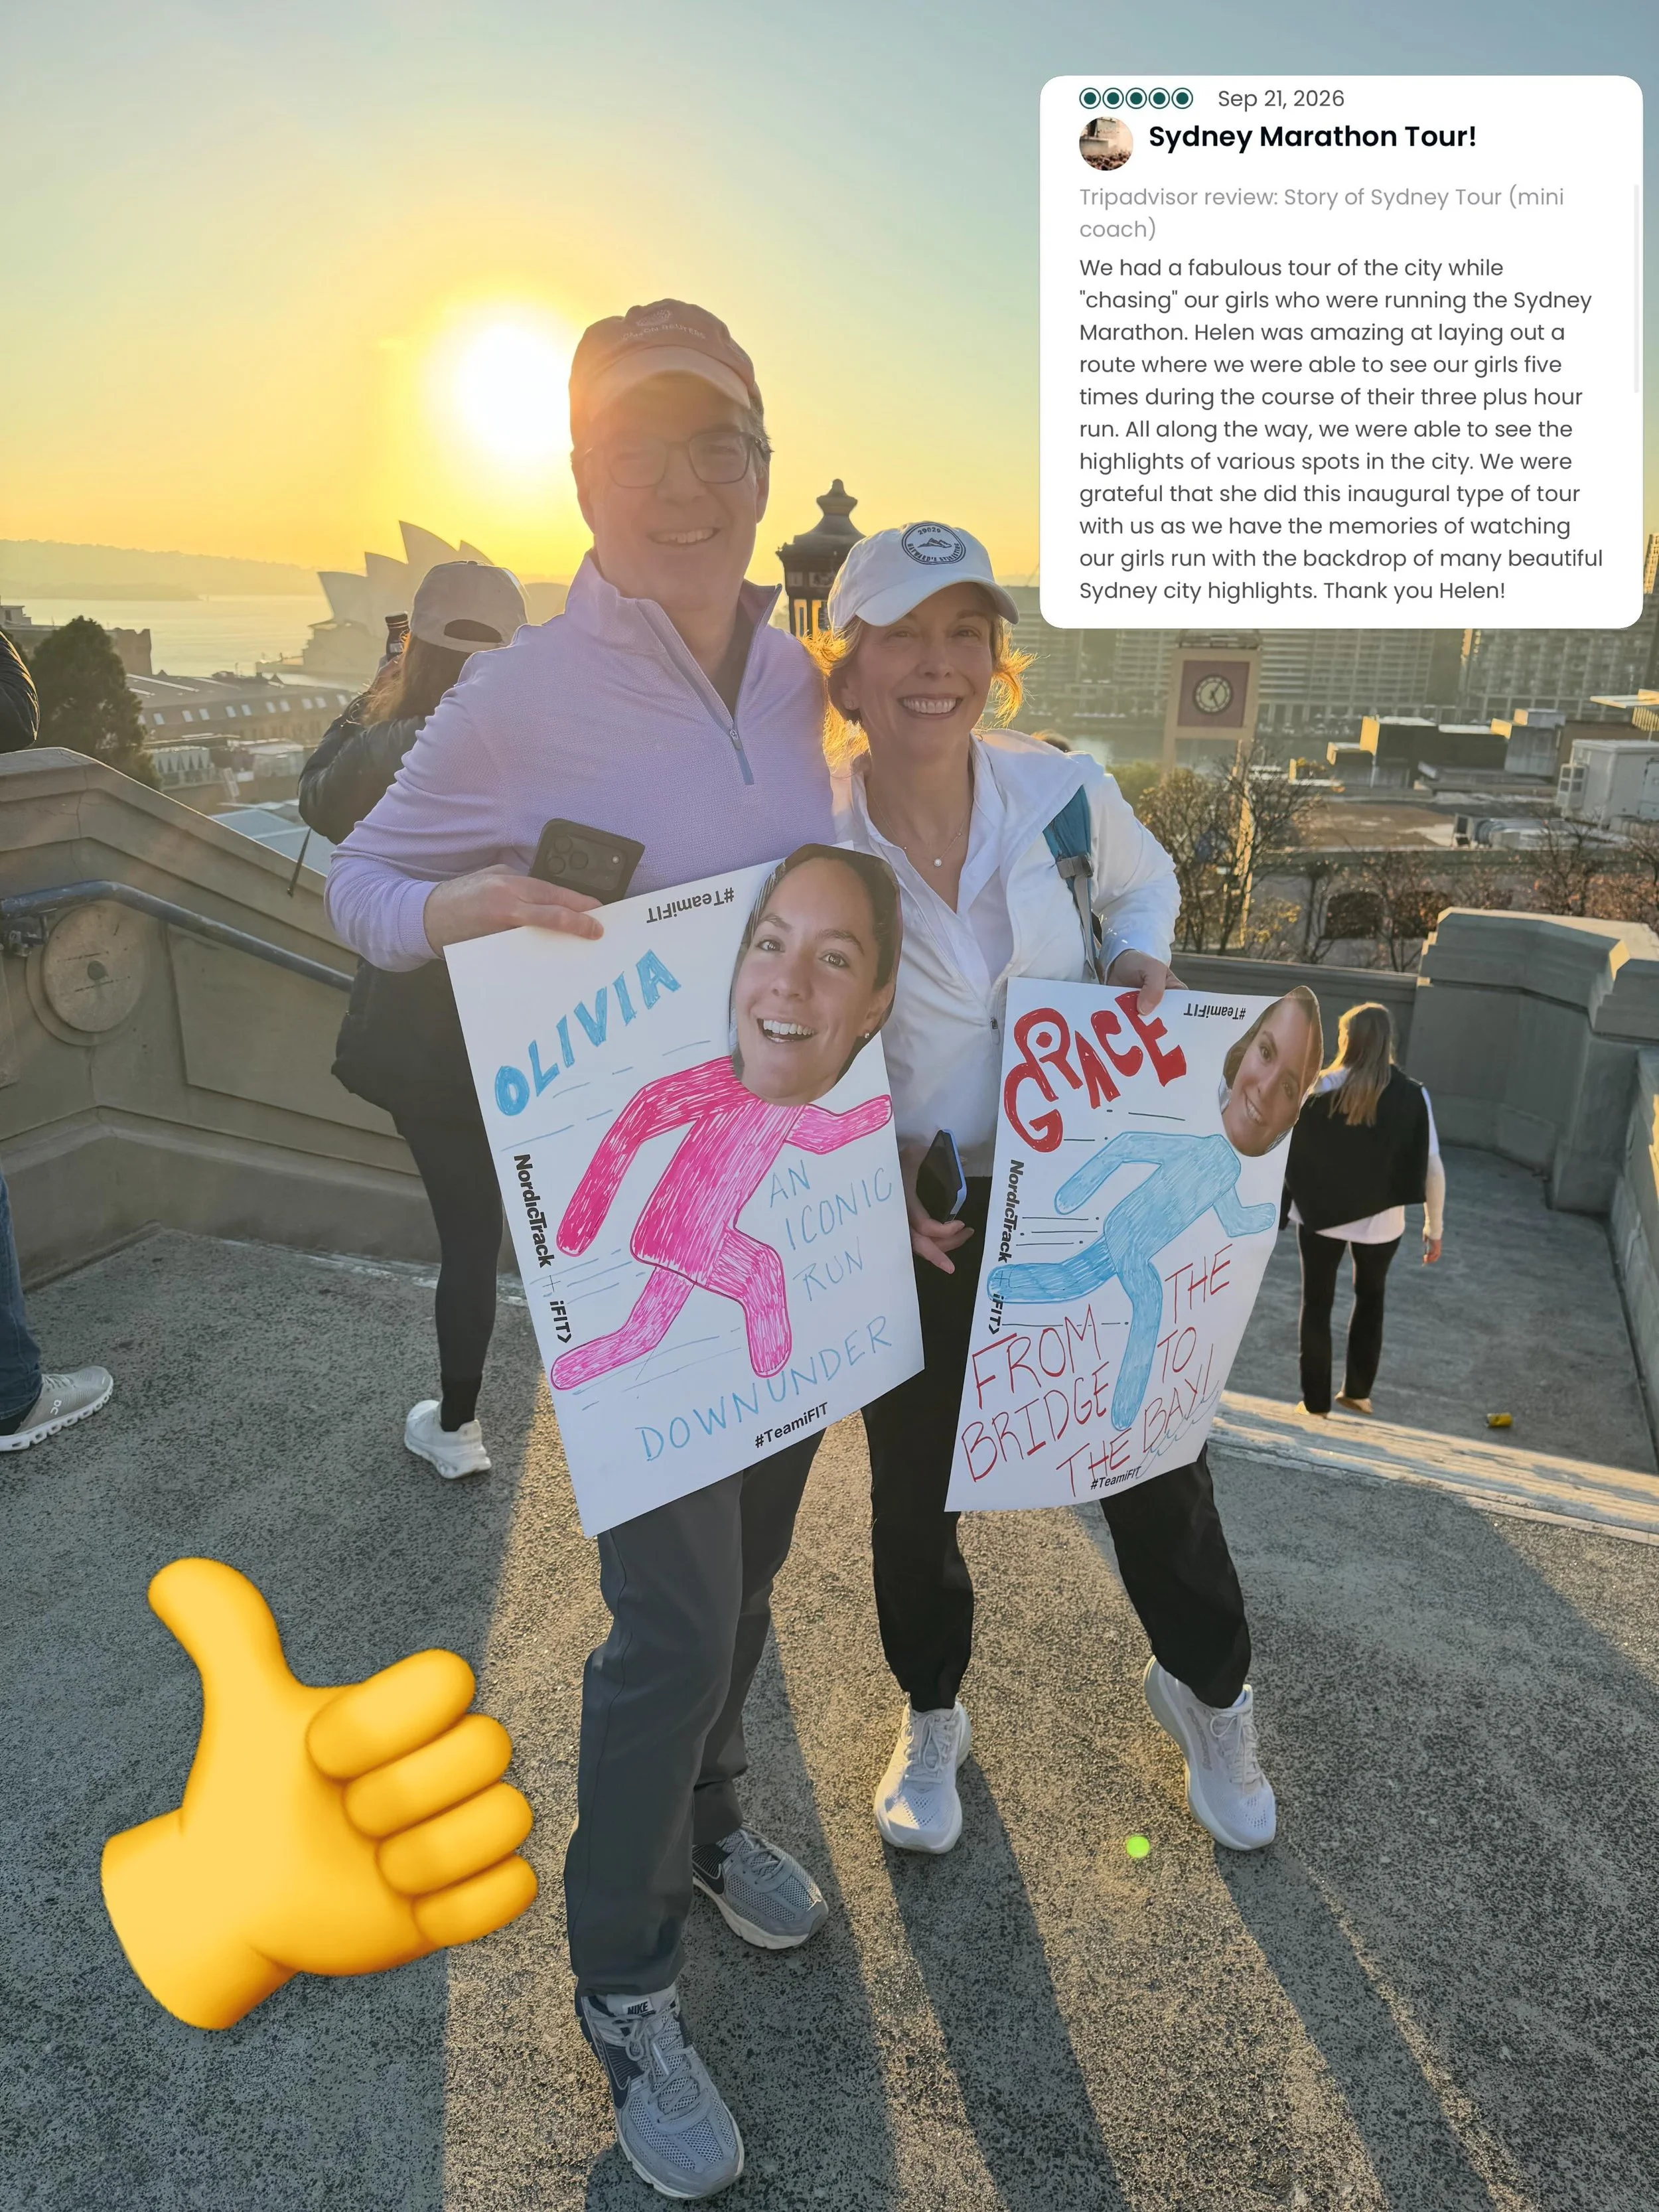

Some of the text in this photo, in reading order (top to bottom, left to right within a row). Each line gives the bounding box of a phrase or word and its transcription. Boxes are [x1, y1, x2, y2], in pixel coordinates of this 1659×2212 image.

[646, 887, 735, 924] #TeamiFIT
[494, 948, 682, 1116] OLIVIA
[1183, 1003, 1246, 1020] #TeamiFIT
[1003, 990, 1187, 1153] GRACE
[514, 1153, 555, 1268] NordicTrack
[770, 1159, 811, 1209] AN
[785, 1167, 893, 1250] ICONIC
[997, 1159, 1025, 1264] NordicTrack
[792, 1236, 863, 1301] RUN
[972, 1243, 1233, 1410] FROM THE
[755, 1402, 828, 1448] #TeamiFIT
[961, 1327, 1197, 1483] BRIDGE TO
[1056, 1428, 1132, 1498] THE
[1090, 1466, 1142, 1491] #TeamiFIT
[627, 2001, 648, 2016] NIKE
